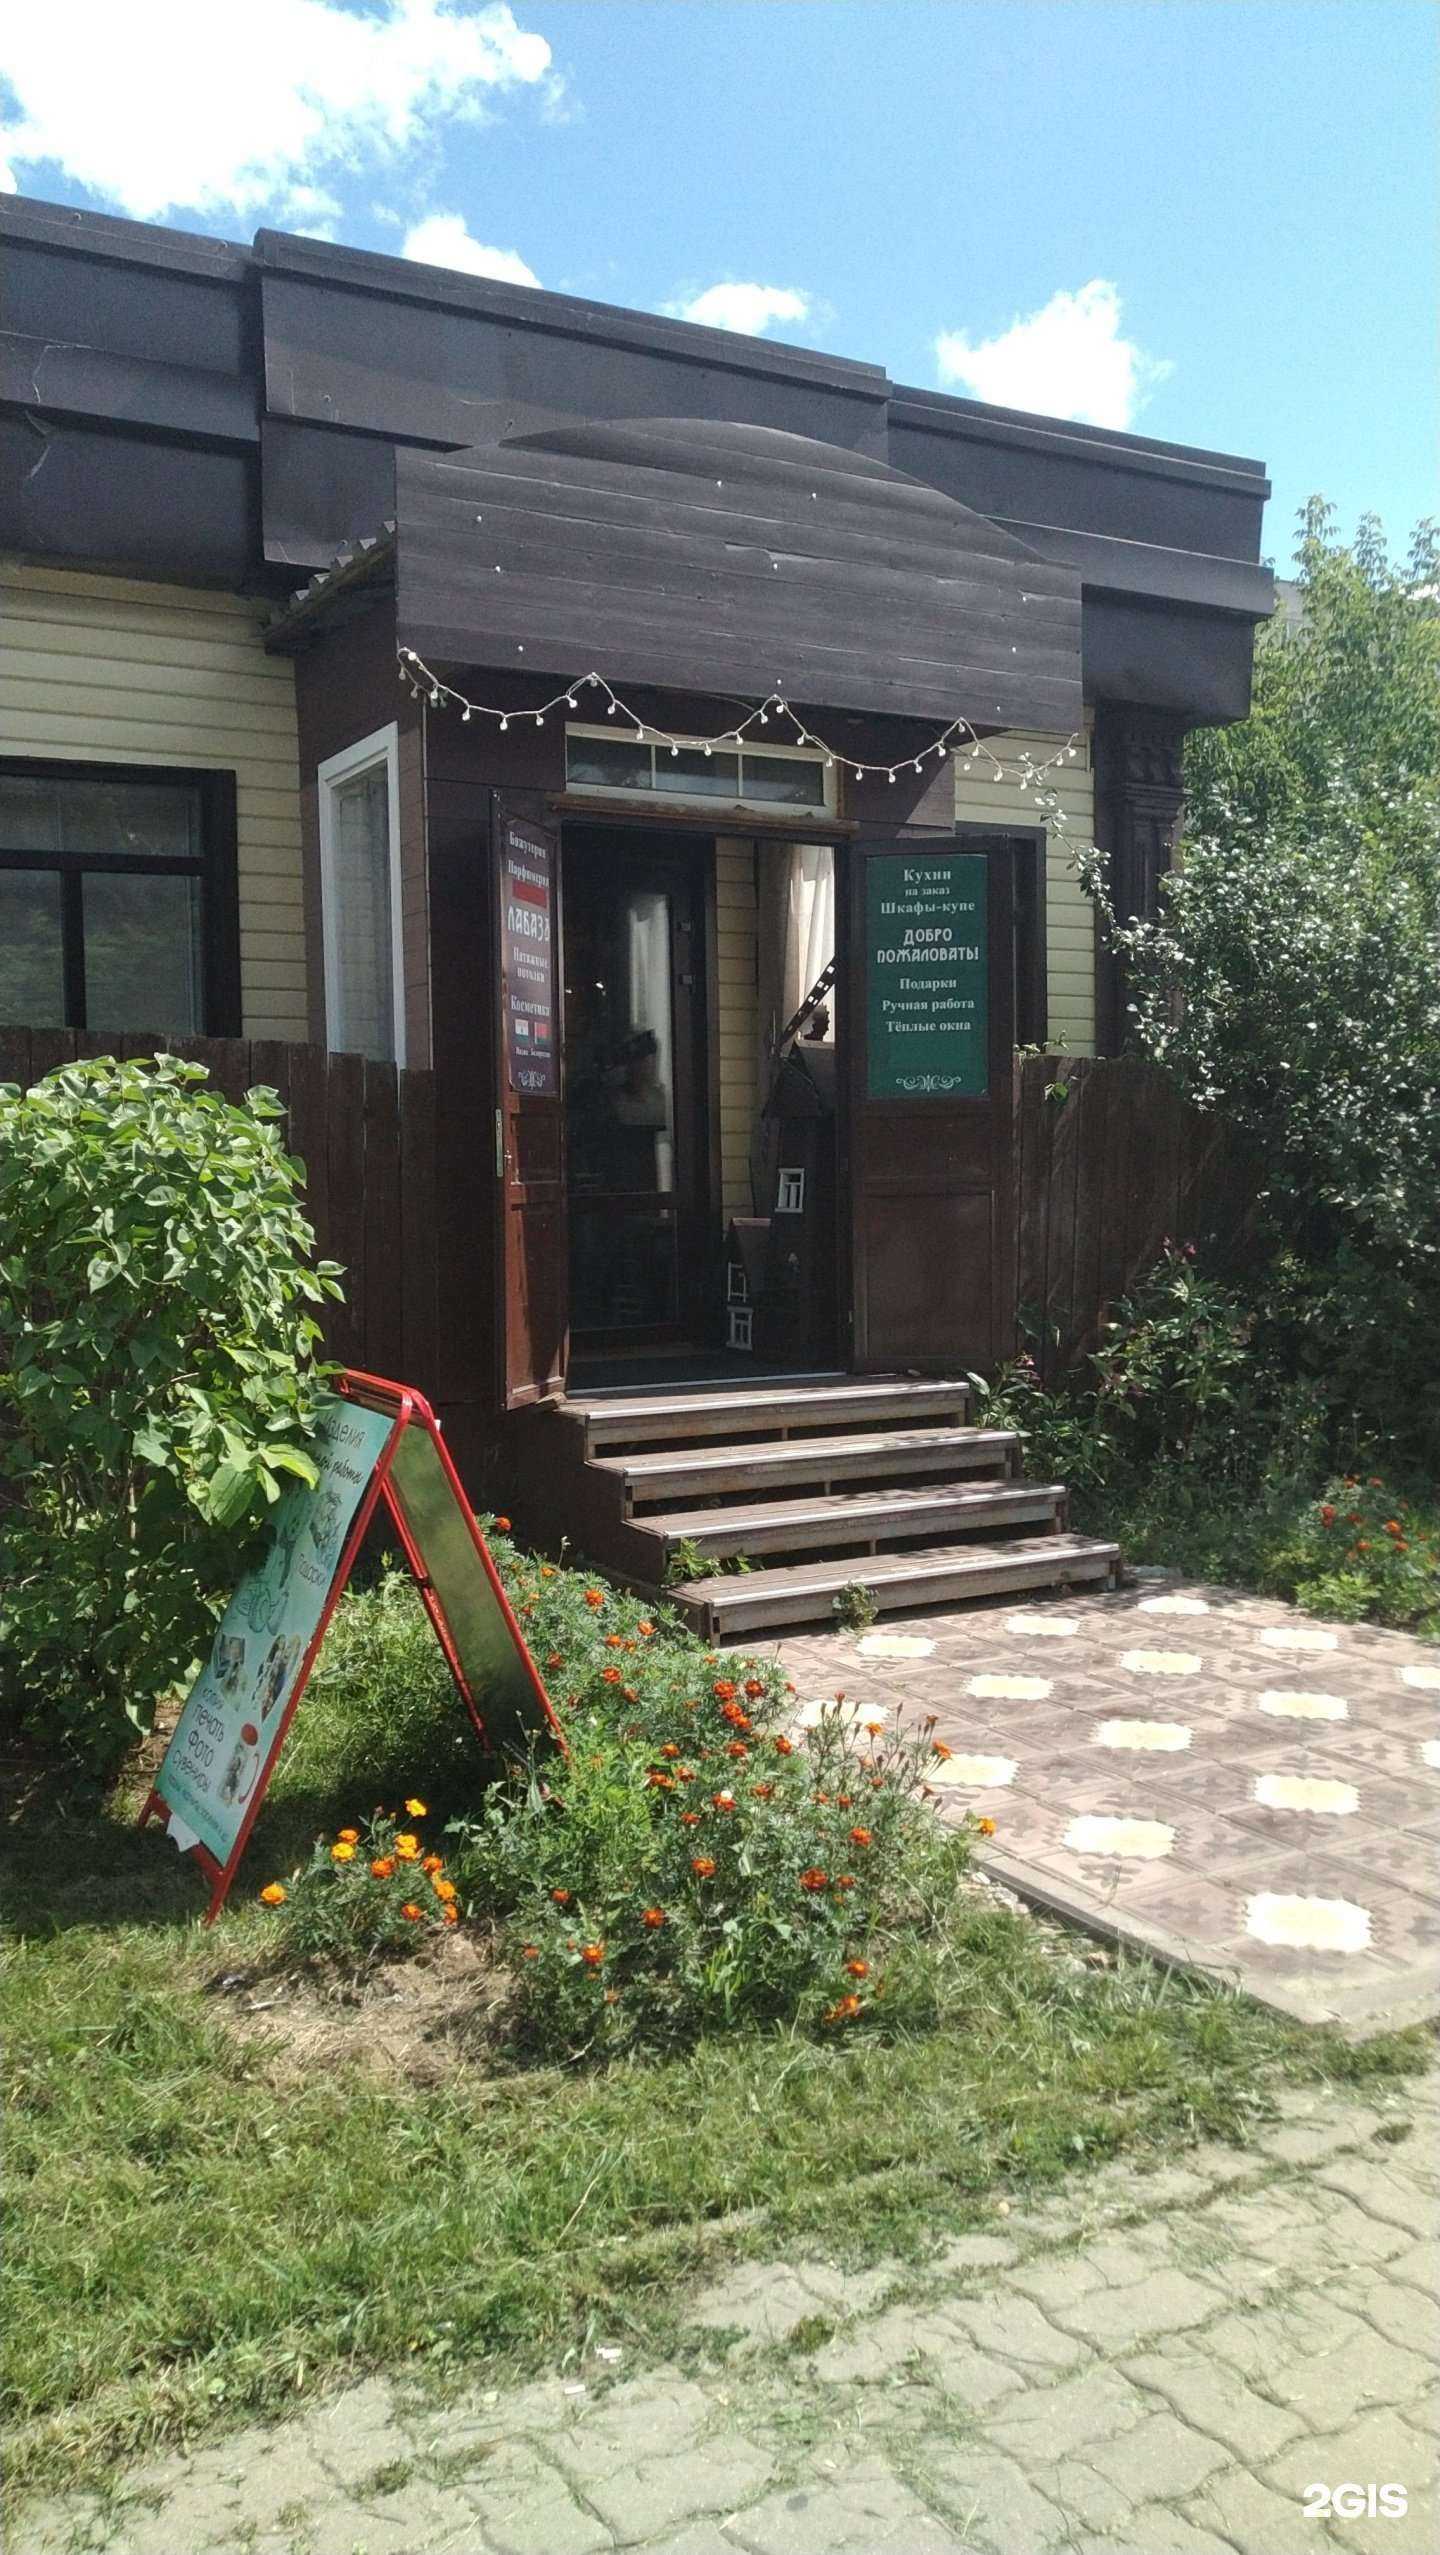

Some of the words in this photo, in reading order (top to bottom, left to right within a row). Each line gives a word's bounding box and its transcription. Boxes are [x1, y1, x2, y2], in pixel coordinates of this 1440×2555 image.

[903, 869, 951, 884] Кухни
[922, 887, 950, 896] заказ
[881, 901, 975, 916] Шкафы-купе
[903, 928, 952, 946] ДОБРО
[877, 947, 979, 963] ПОЖАЛОВАТЬ!
[900, 978, 957, 992] Подарки
[882, 1000, 928, 1014] Ручная
[931, 998, 975, 1012] работа
[886, 1021, 936, 1032] Тёплые
[939, 1022, 971, 1031] окна
